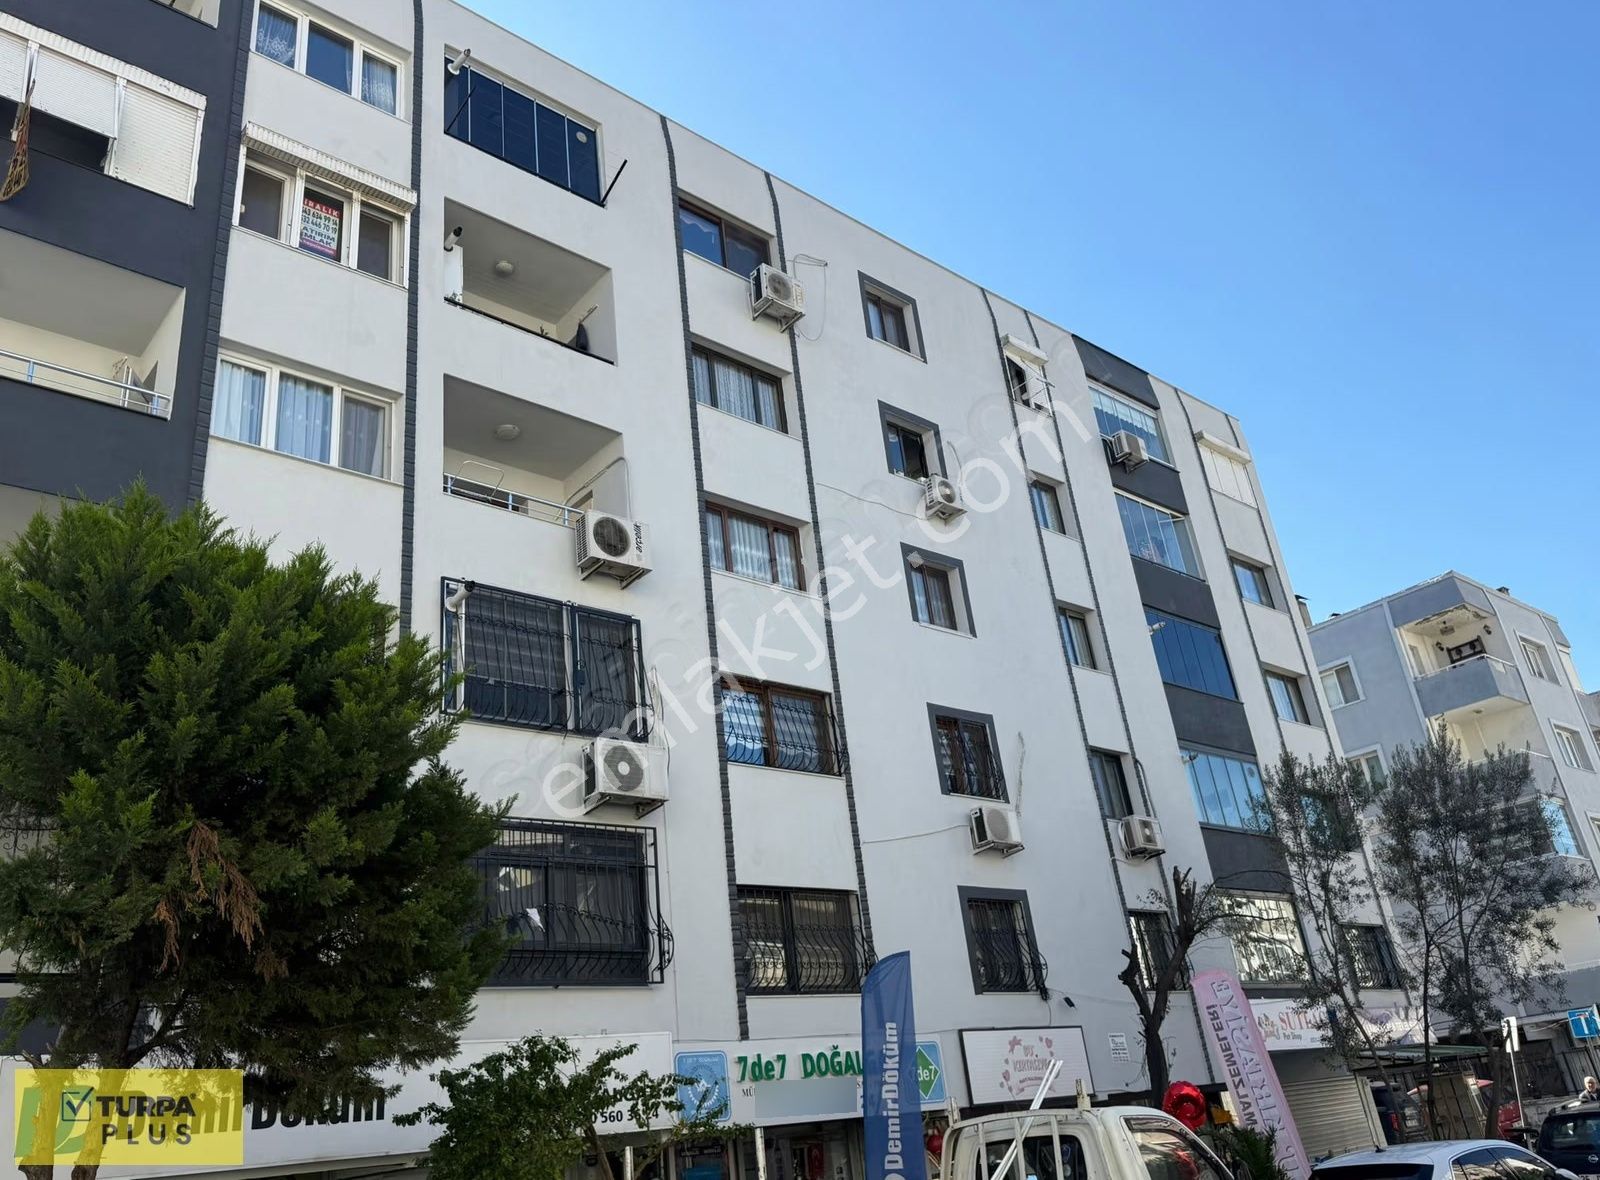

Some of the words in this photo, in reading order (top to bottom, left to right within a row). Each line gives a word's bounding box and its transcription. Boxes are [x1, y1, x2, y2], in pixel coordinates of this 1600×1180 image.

[737, 1053, 787, 1083] 7de7
[913, 1065, 936, 1081] de7
[881, 1021, 904, 1170] DemirDöküm
[600, 1110, 623, 1123] 560
